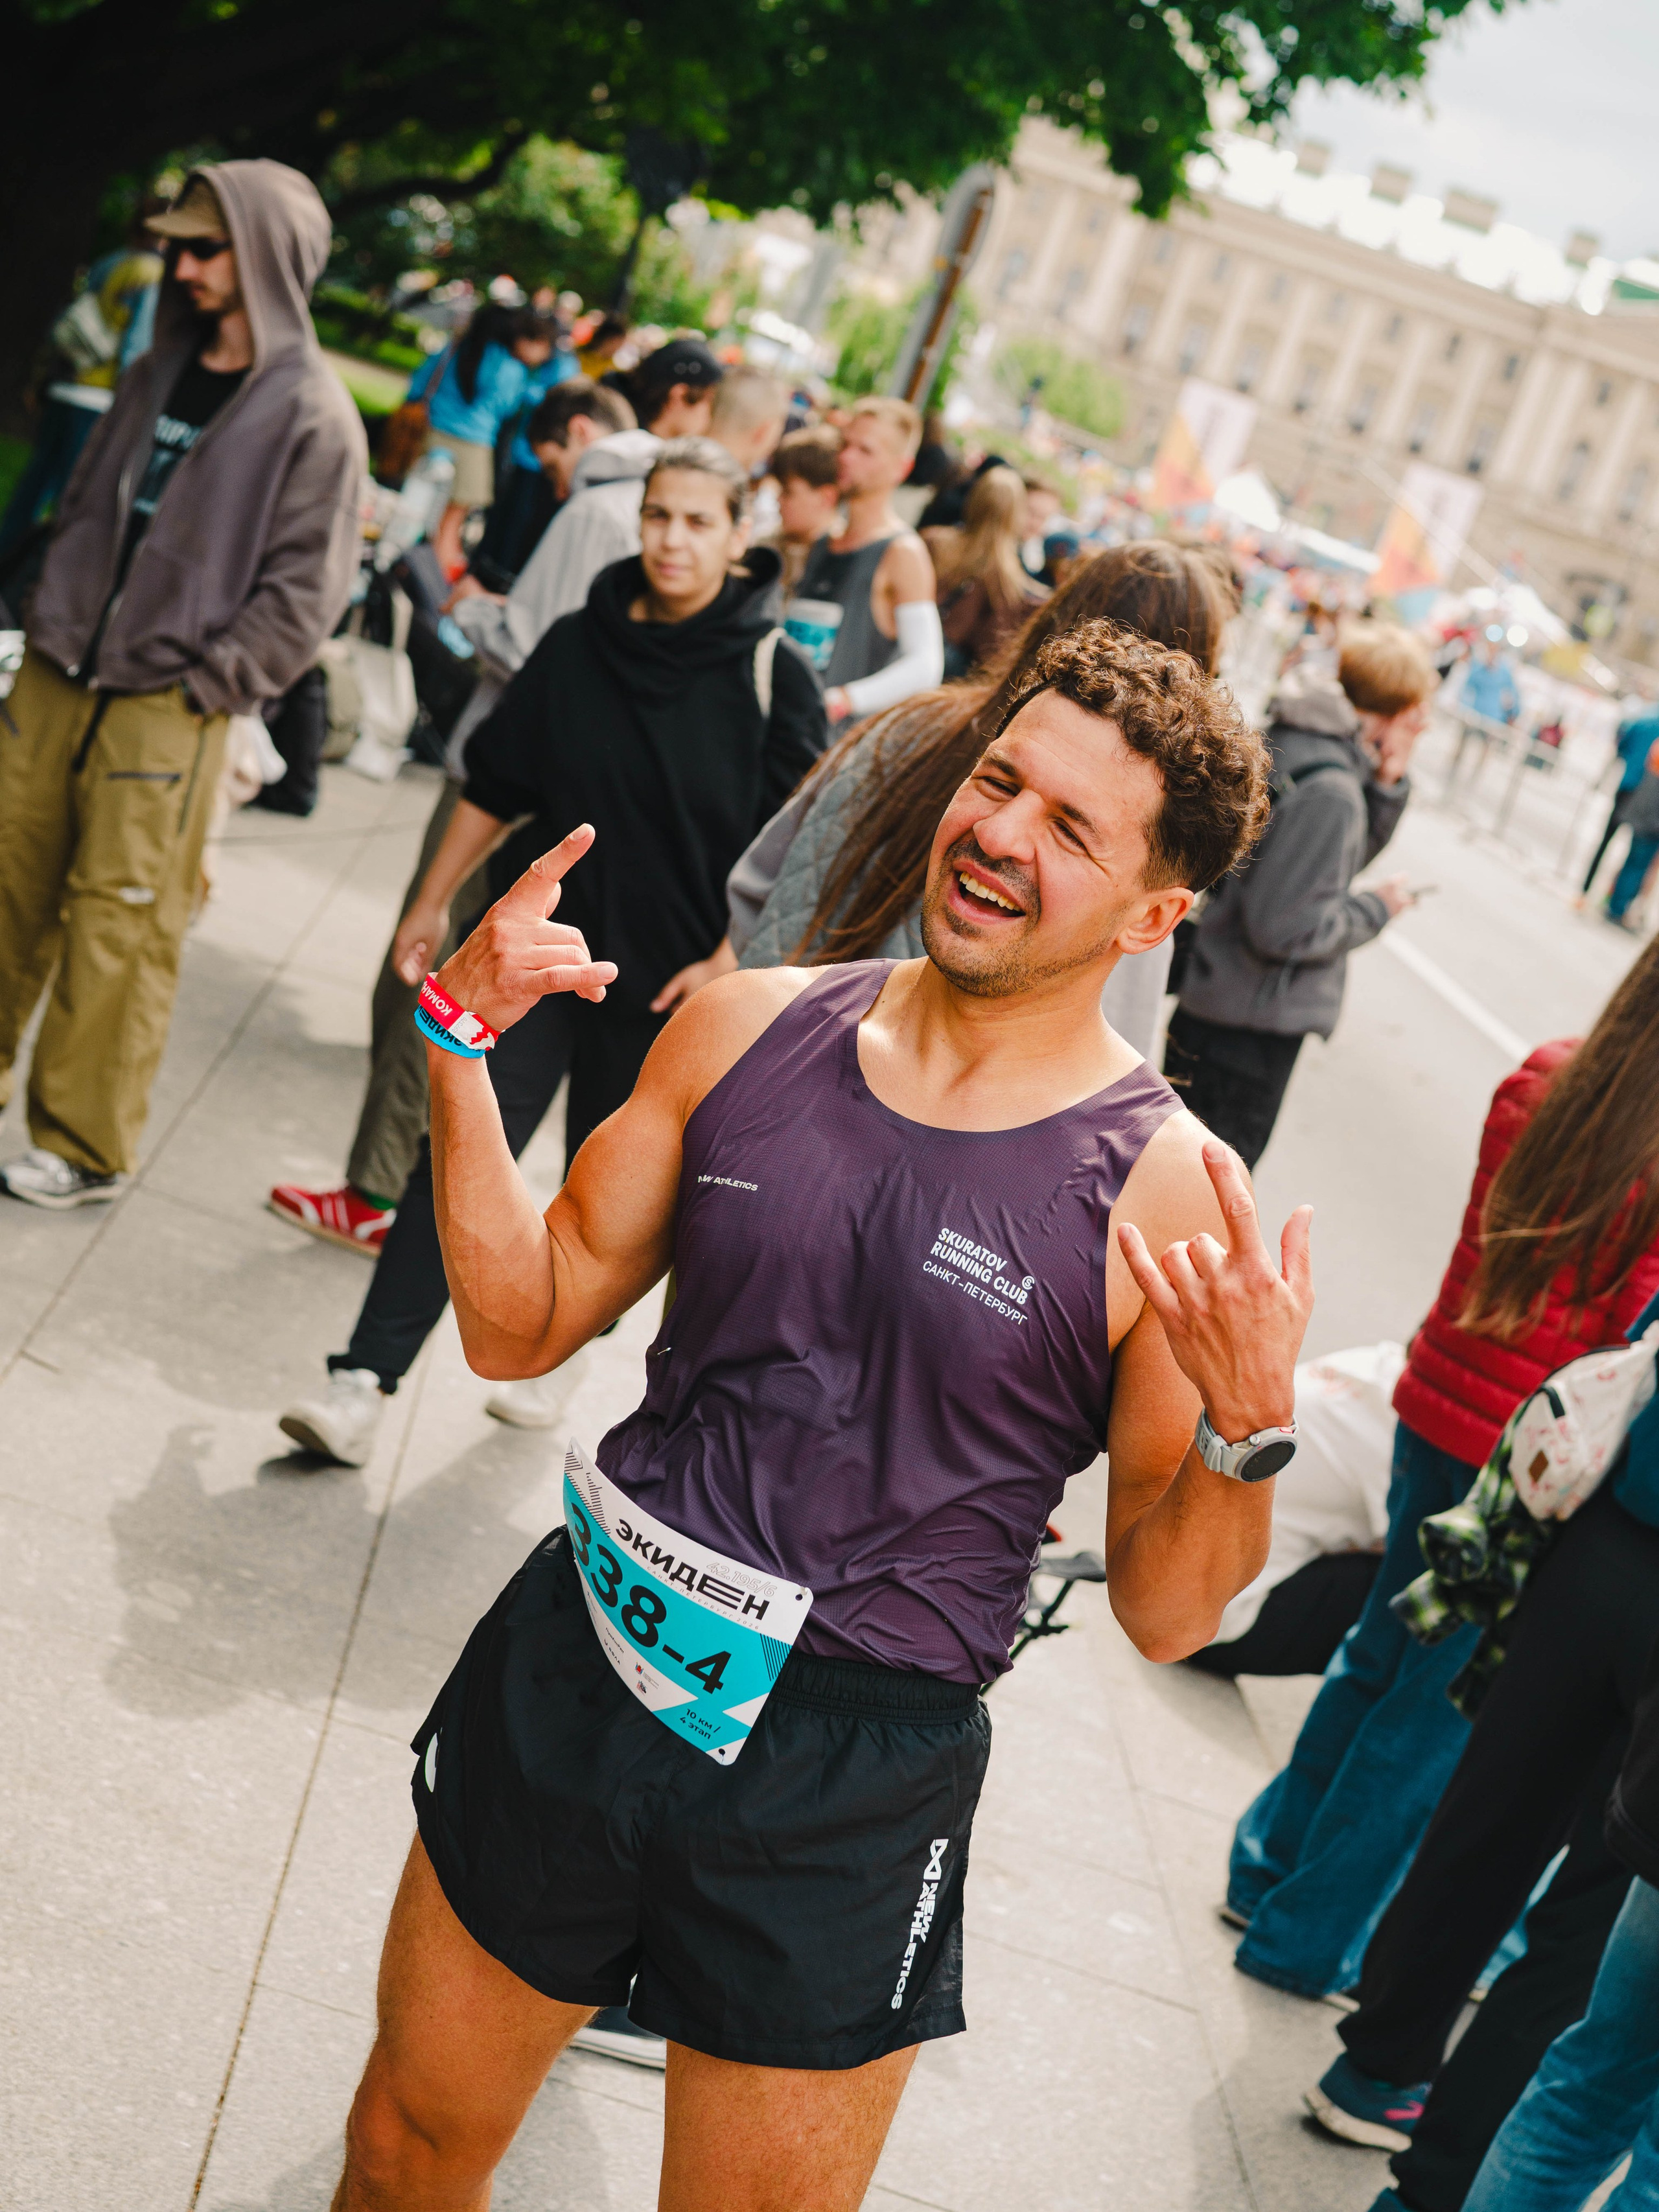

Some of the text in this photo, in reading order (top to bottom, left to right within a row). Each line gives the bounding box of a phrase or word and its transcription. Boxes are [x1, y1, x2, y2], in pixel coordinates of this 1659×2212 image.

[930, 1241, 1028, 1305] RUNNING CLUB
[938, 1228, 1007, 1272] SKURATOV
[923, 1261, 1028, 1325] САНКТ-ПЕТЕРБУРГ
[570, 1502, 732, 1694] 338-4
[616, 1519, 770, 1620] ЭКИДЕН
[706, 1562, 778, 1597] 42.195/6
[736, 1617, 759, 1630] 2026
[686, 1708, 697, 1719] 10
[698, 1717, 713, 1730] км
[688, 1722, 712, 1740] этап
[920, 1882, 938, 1943] NEW
[891, 1881, 931, 2009] ATHLETICS
